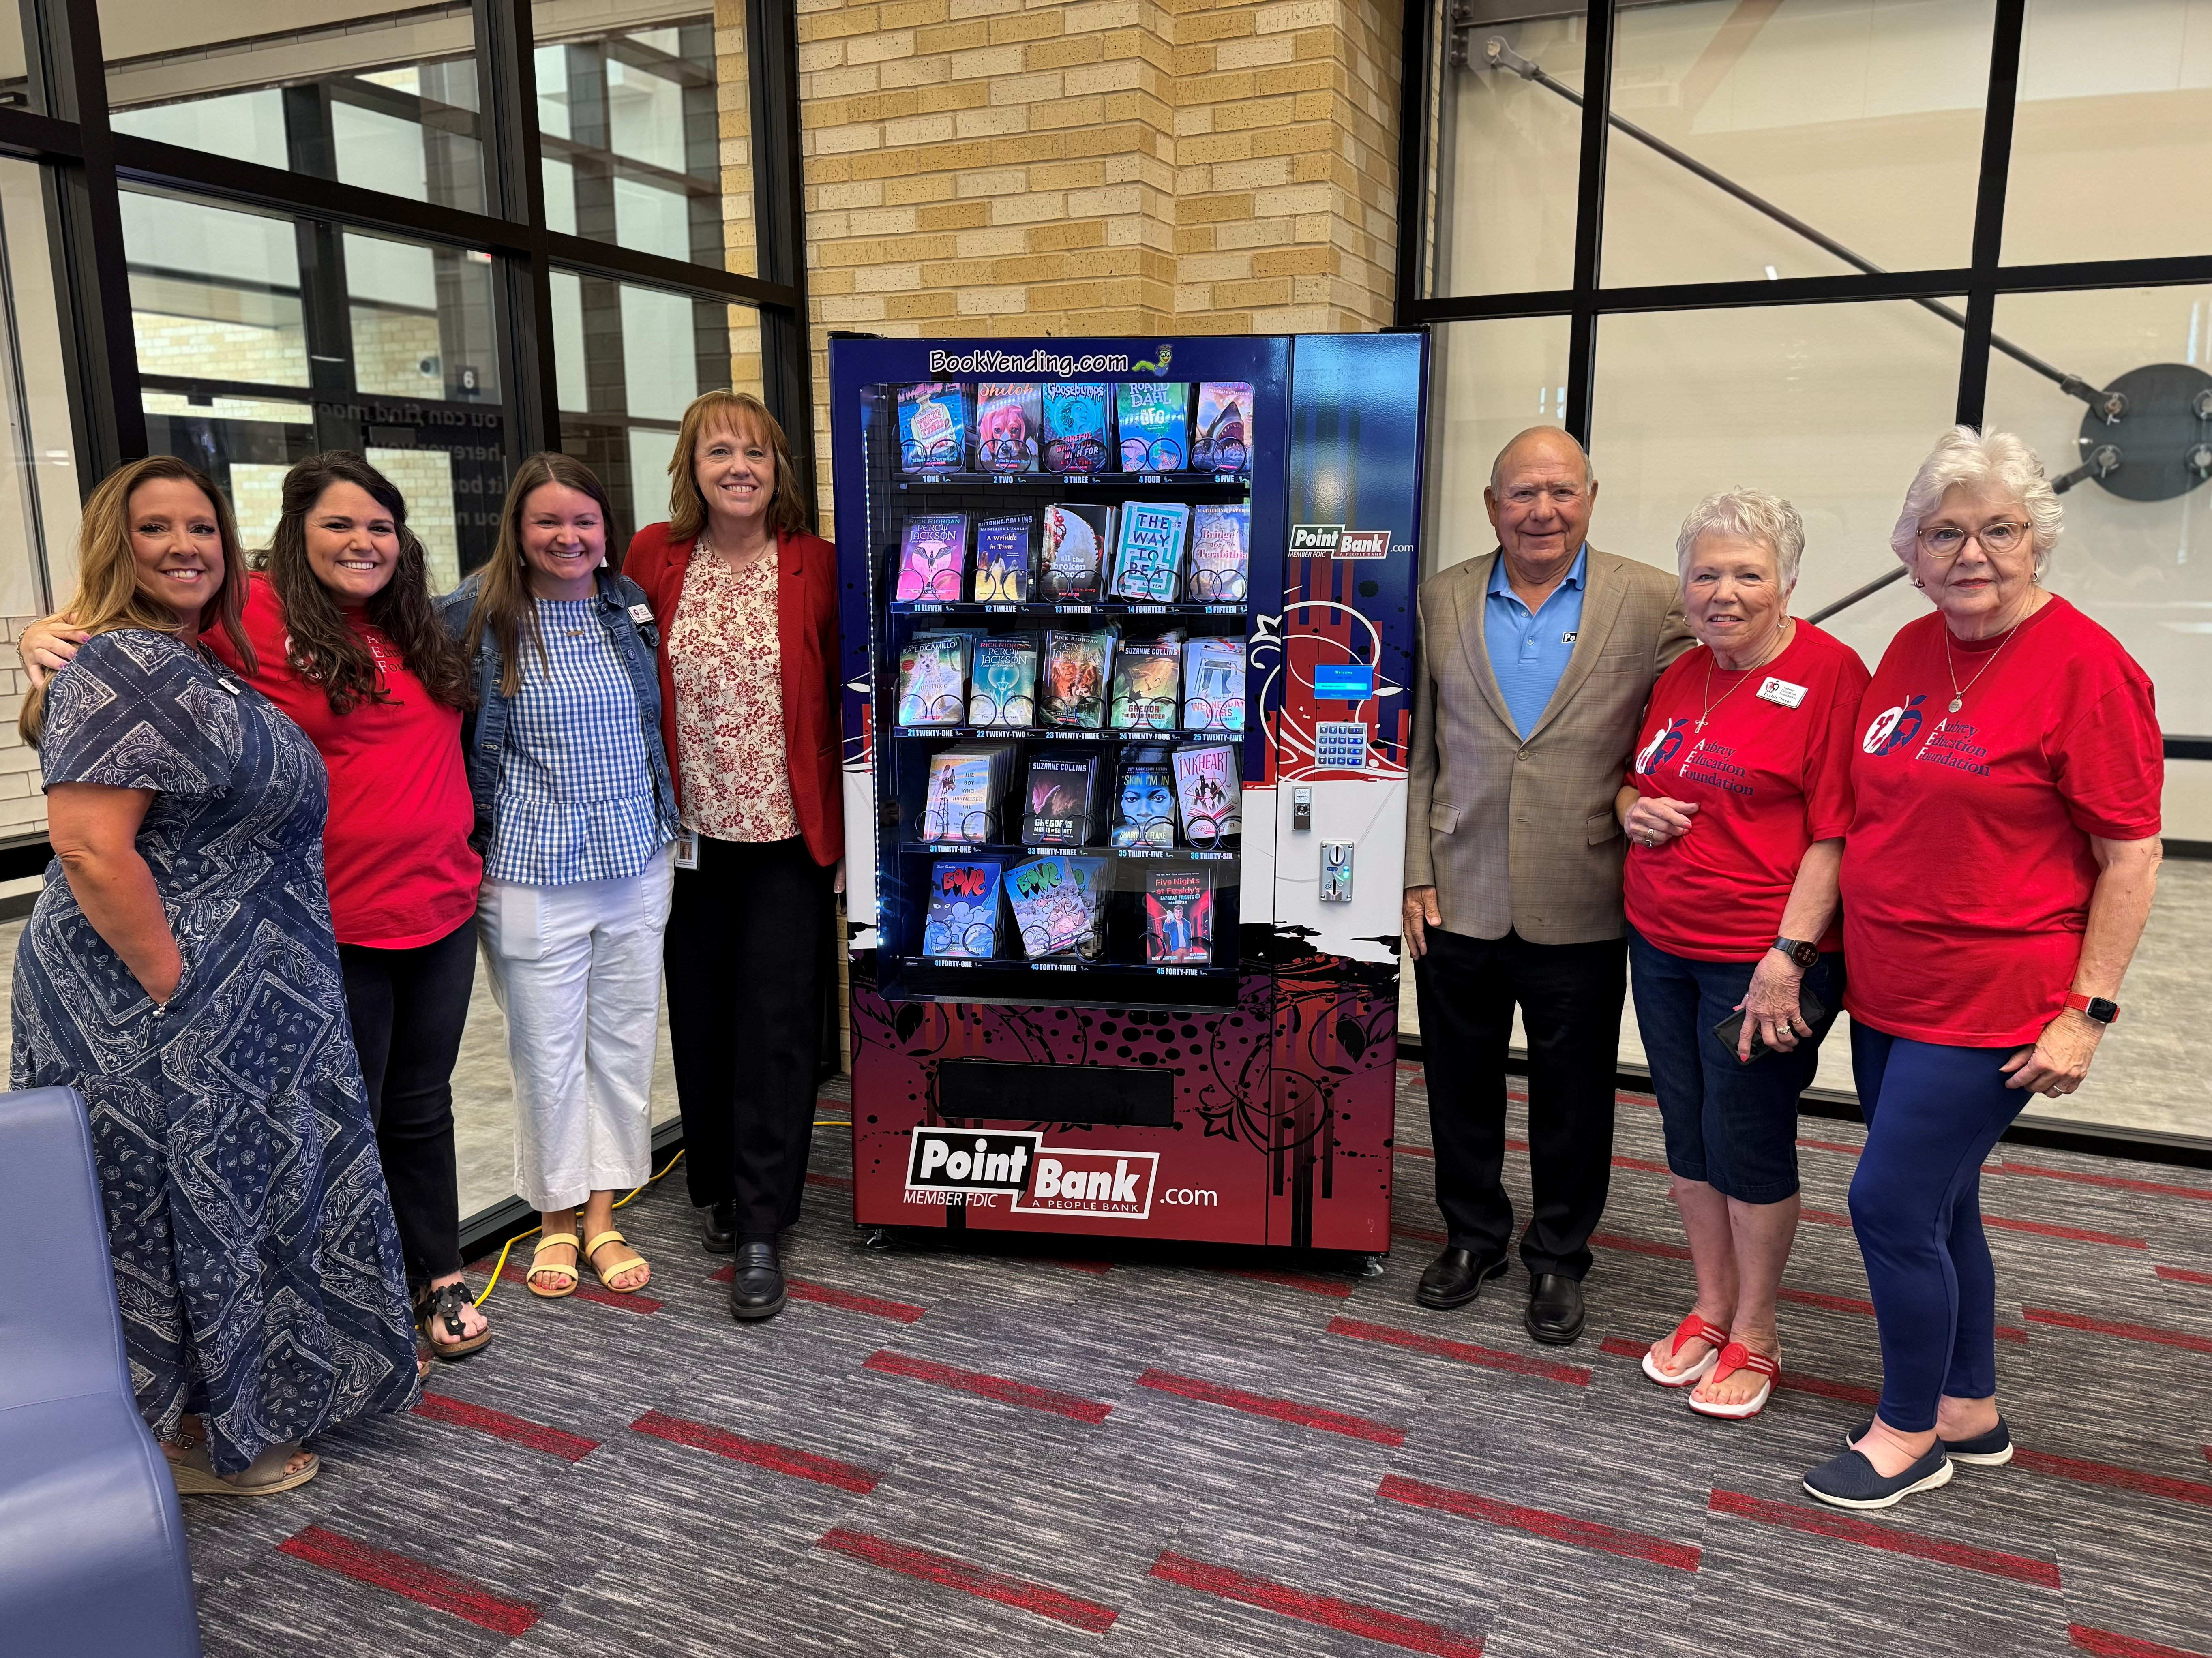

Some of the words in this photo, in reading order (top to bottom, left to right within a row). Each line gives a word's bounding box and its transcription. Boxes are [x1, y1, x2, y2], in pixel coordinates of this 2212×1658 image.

[930, 350, 1128, 377] BookVending.com
[463, 370, 474, 389] 6
[980, 383, 1034, 397] Shiloh
[1047, 383, 1104, 405] Goosebumps
[1129, 383, 1170, 395] ROALD
[1130, 391, 1172, 408] DAHL
[917, 408, 941, 429] THREE
[1062, 432, 1092, 443] CAREFUL
[1084, 446, 1099, 456] FOR
[917, 523, 949, 532] PERCY
[1138, 514, 1170, 529] THE
[910, 531, 957, 542] JACKSON
[993, 533, 1017, 541] Wrinkle
[1133, 531, 1170, 547] WAY
[1203, 529, 1235, 540] Bridge
[1295, 528, 1339, 546] Point
[1340, 534, 1384, 553] Bank
[1390, 544, 1414, 552] .com
[1137, 548, 1159, 561] TO
[1198, 549, 1248, 559] Terabithia
[1053, 562, 1086, 570] broken
[1129, 562, 1161, 578] BEA
[1055, 569, 1086, 579] pieces
[1564, 633, 1576, 642] Po
[903, 647, 918, 655] KATE
[988, 648, 1020, 656] PERCY
[1060, 642, 1090, 651] PERCY
[1152, 648, 1177, 656] COLLINS
[980, 655, 1027, 667] JACKSON
[1052, 649, 1100, 663] JACKSON
[1128, 705, 1160, 713] GREGOR
[1206, 709, 1232, 718] WARS
[1934, 718, 1979, 739] Aubrey
[1693, 739, 1737, 757] Aubrey
[1925, 732, 1987, 758] Education
[1033, 762, 1059, 770] SUZANNE
[1060, 763, 1087, 772] COLLINS
[1179, 751, 1231, 781] INKHEART
[1684, 751, 1746, 778] Education
[1915, 747, 1991, 777] Foundation
[1124, 775, 1142, 786] SKIN
[1146, 775, 1158, 786] I'M
[1161, 775, 1170, 786] IN
[1678, 764, 1754, 797] Foundation
[943, 867, 986, 898] BONE
[1016, 861, 1063, 899] BONE
[1174, 878, 1200, 886] Nights
[1167, 887, 1200, 895] Freddy's
[1045, 938, 1060, 947] GEAT
[920, 1138, 1028, 1181] Point
[1034, 1158, 1140, 1202] Bank
[1159, 1187, 1218, 1206] .com
[903, 1190, 962, 1206] MEMBER
[965, 1193, 998, 1208] FDIC
[1031, 1199, 1040, 1207] A
[1048, 1200, 1097, 1211] PEOPLE
[1102, 1203, 1139, 1212] BANK
